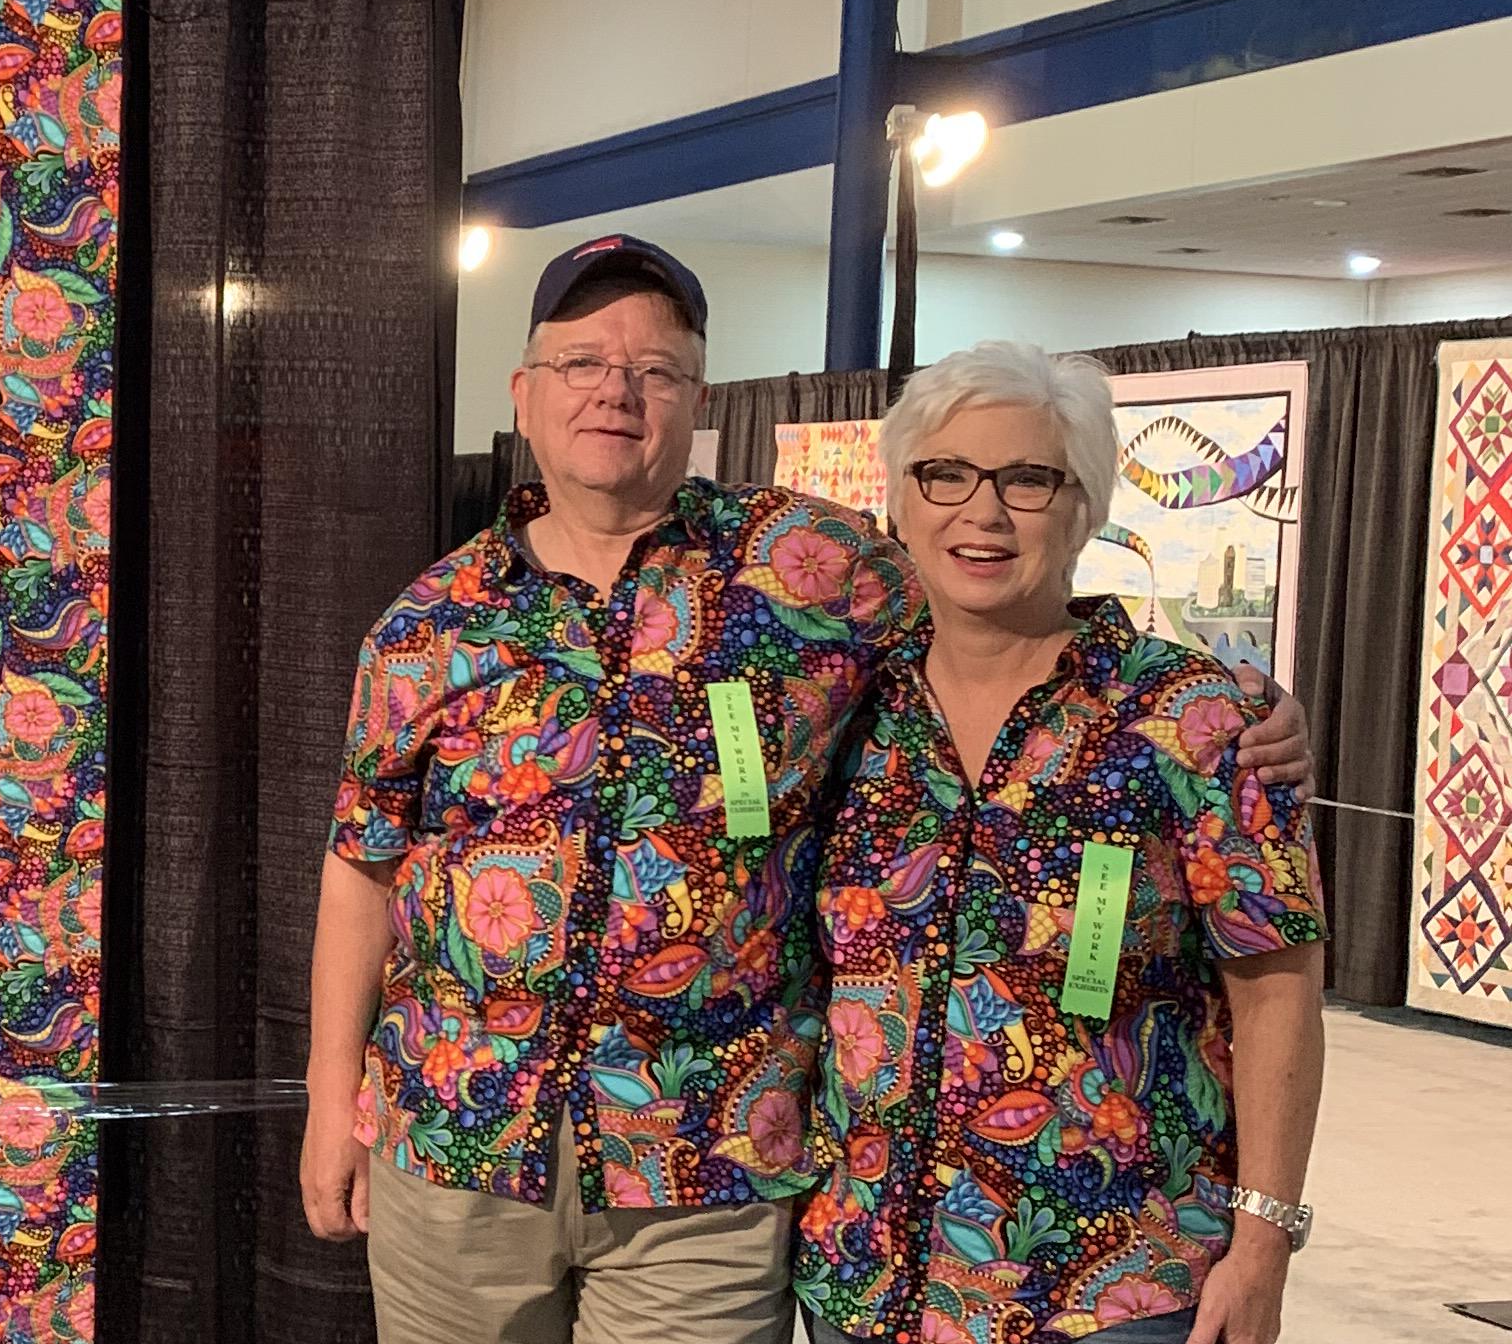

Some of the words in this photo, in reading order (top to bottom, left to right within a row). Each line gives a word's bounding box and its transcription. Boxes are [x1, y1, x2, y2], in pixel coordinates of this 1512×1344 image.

[726, 693, 735, 719] SEE
[730, 725, 740, 742] MY
[734, 748, 747, 784] WORK
[1099, 863, 1109, 891] SEE
[1096, 896, 1106, 915] MY
[1089, 921, 1104, 961] WORK
[1071, 974, 1106, 986] SPECIAL
